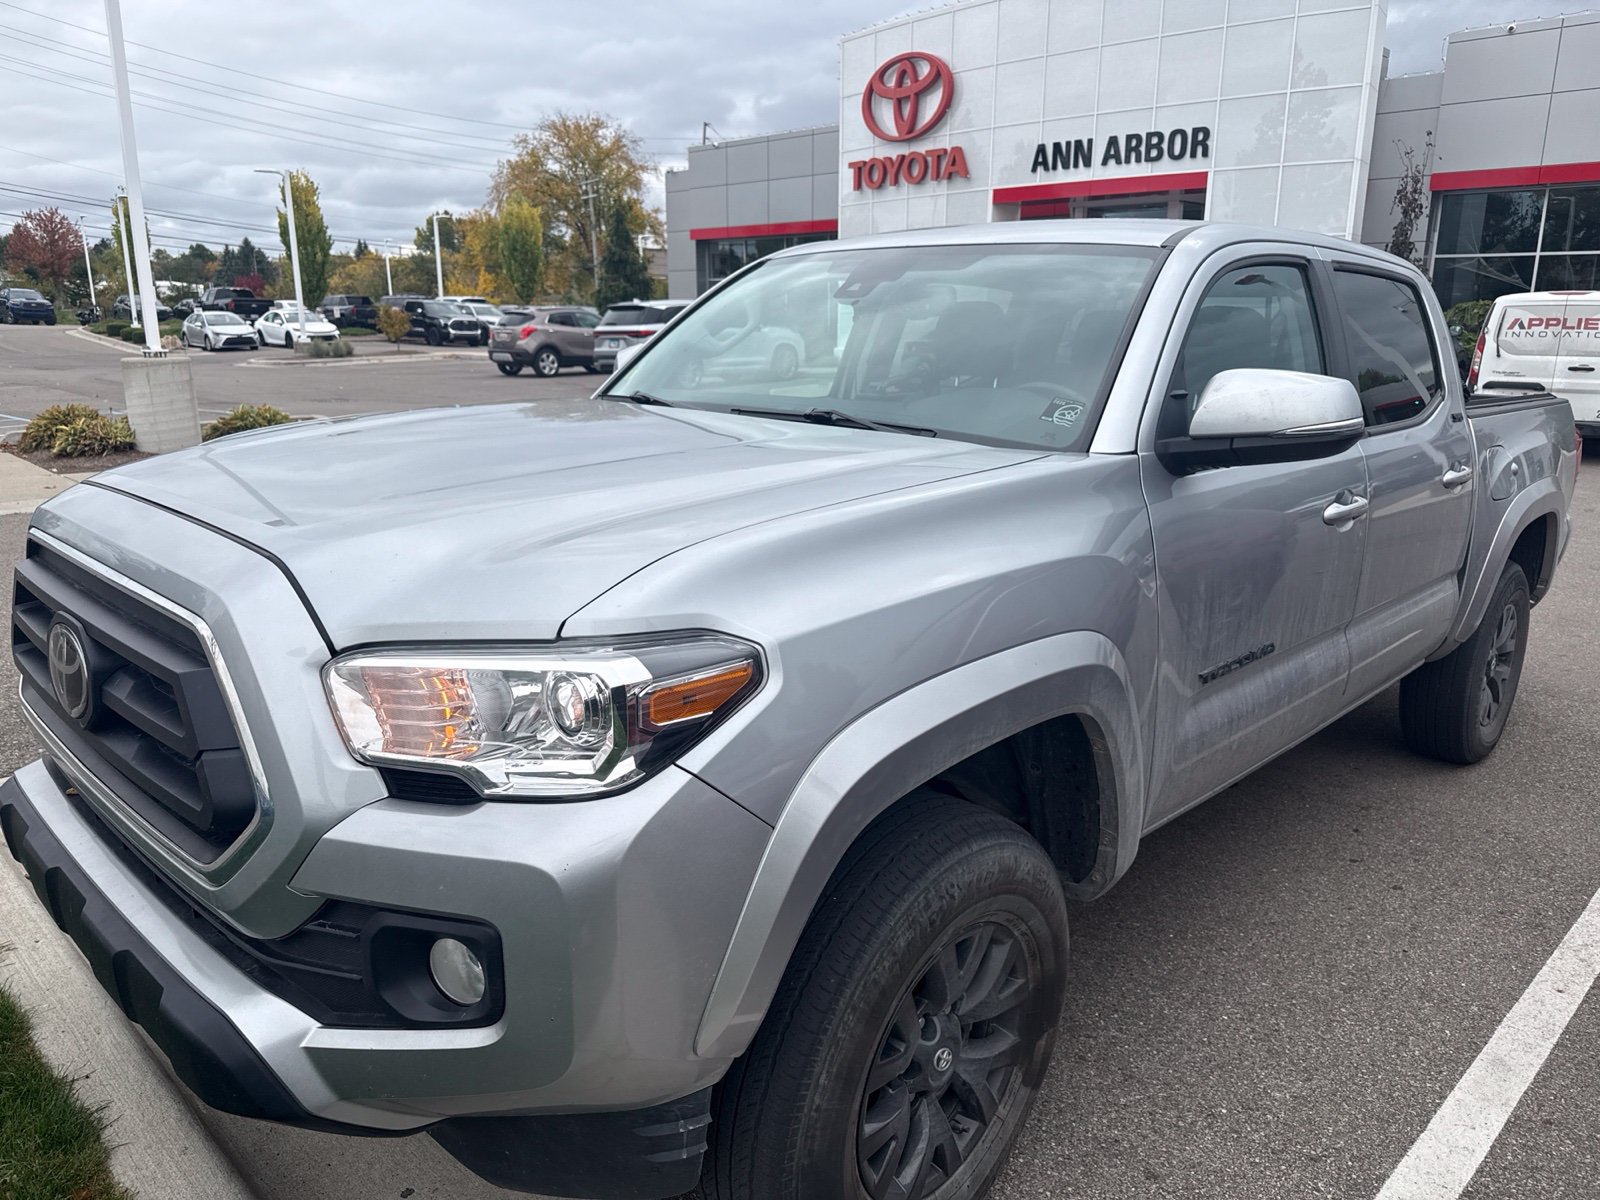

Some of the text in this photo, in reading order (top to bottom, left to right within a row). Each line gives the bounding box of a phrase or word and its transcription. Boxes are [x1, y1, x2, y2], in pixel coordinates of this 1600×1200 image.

[848, 146, 970, 191] TOYOTA
[1031, 126, 1211, 173] ANN ARBOR
